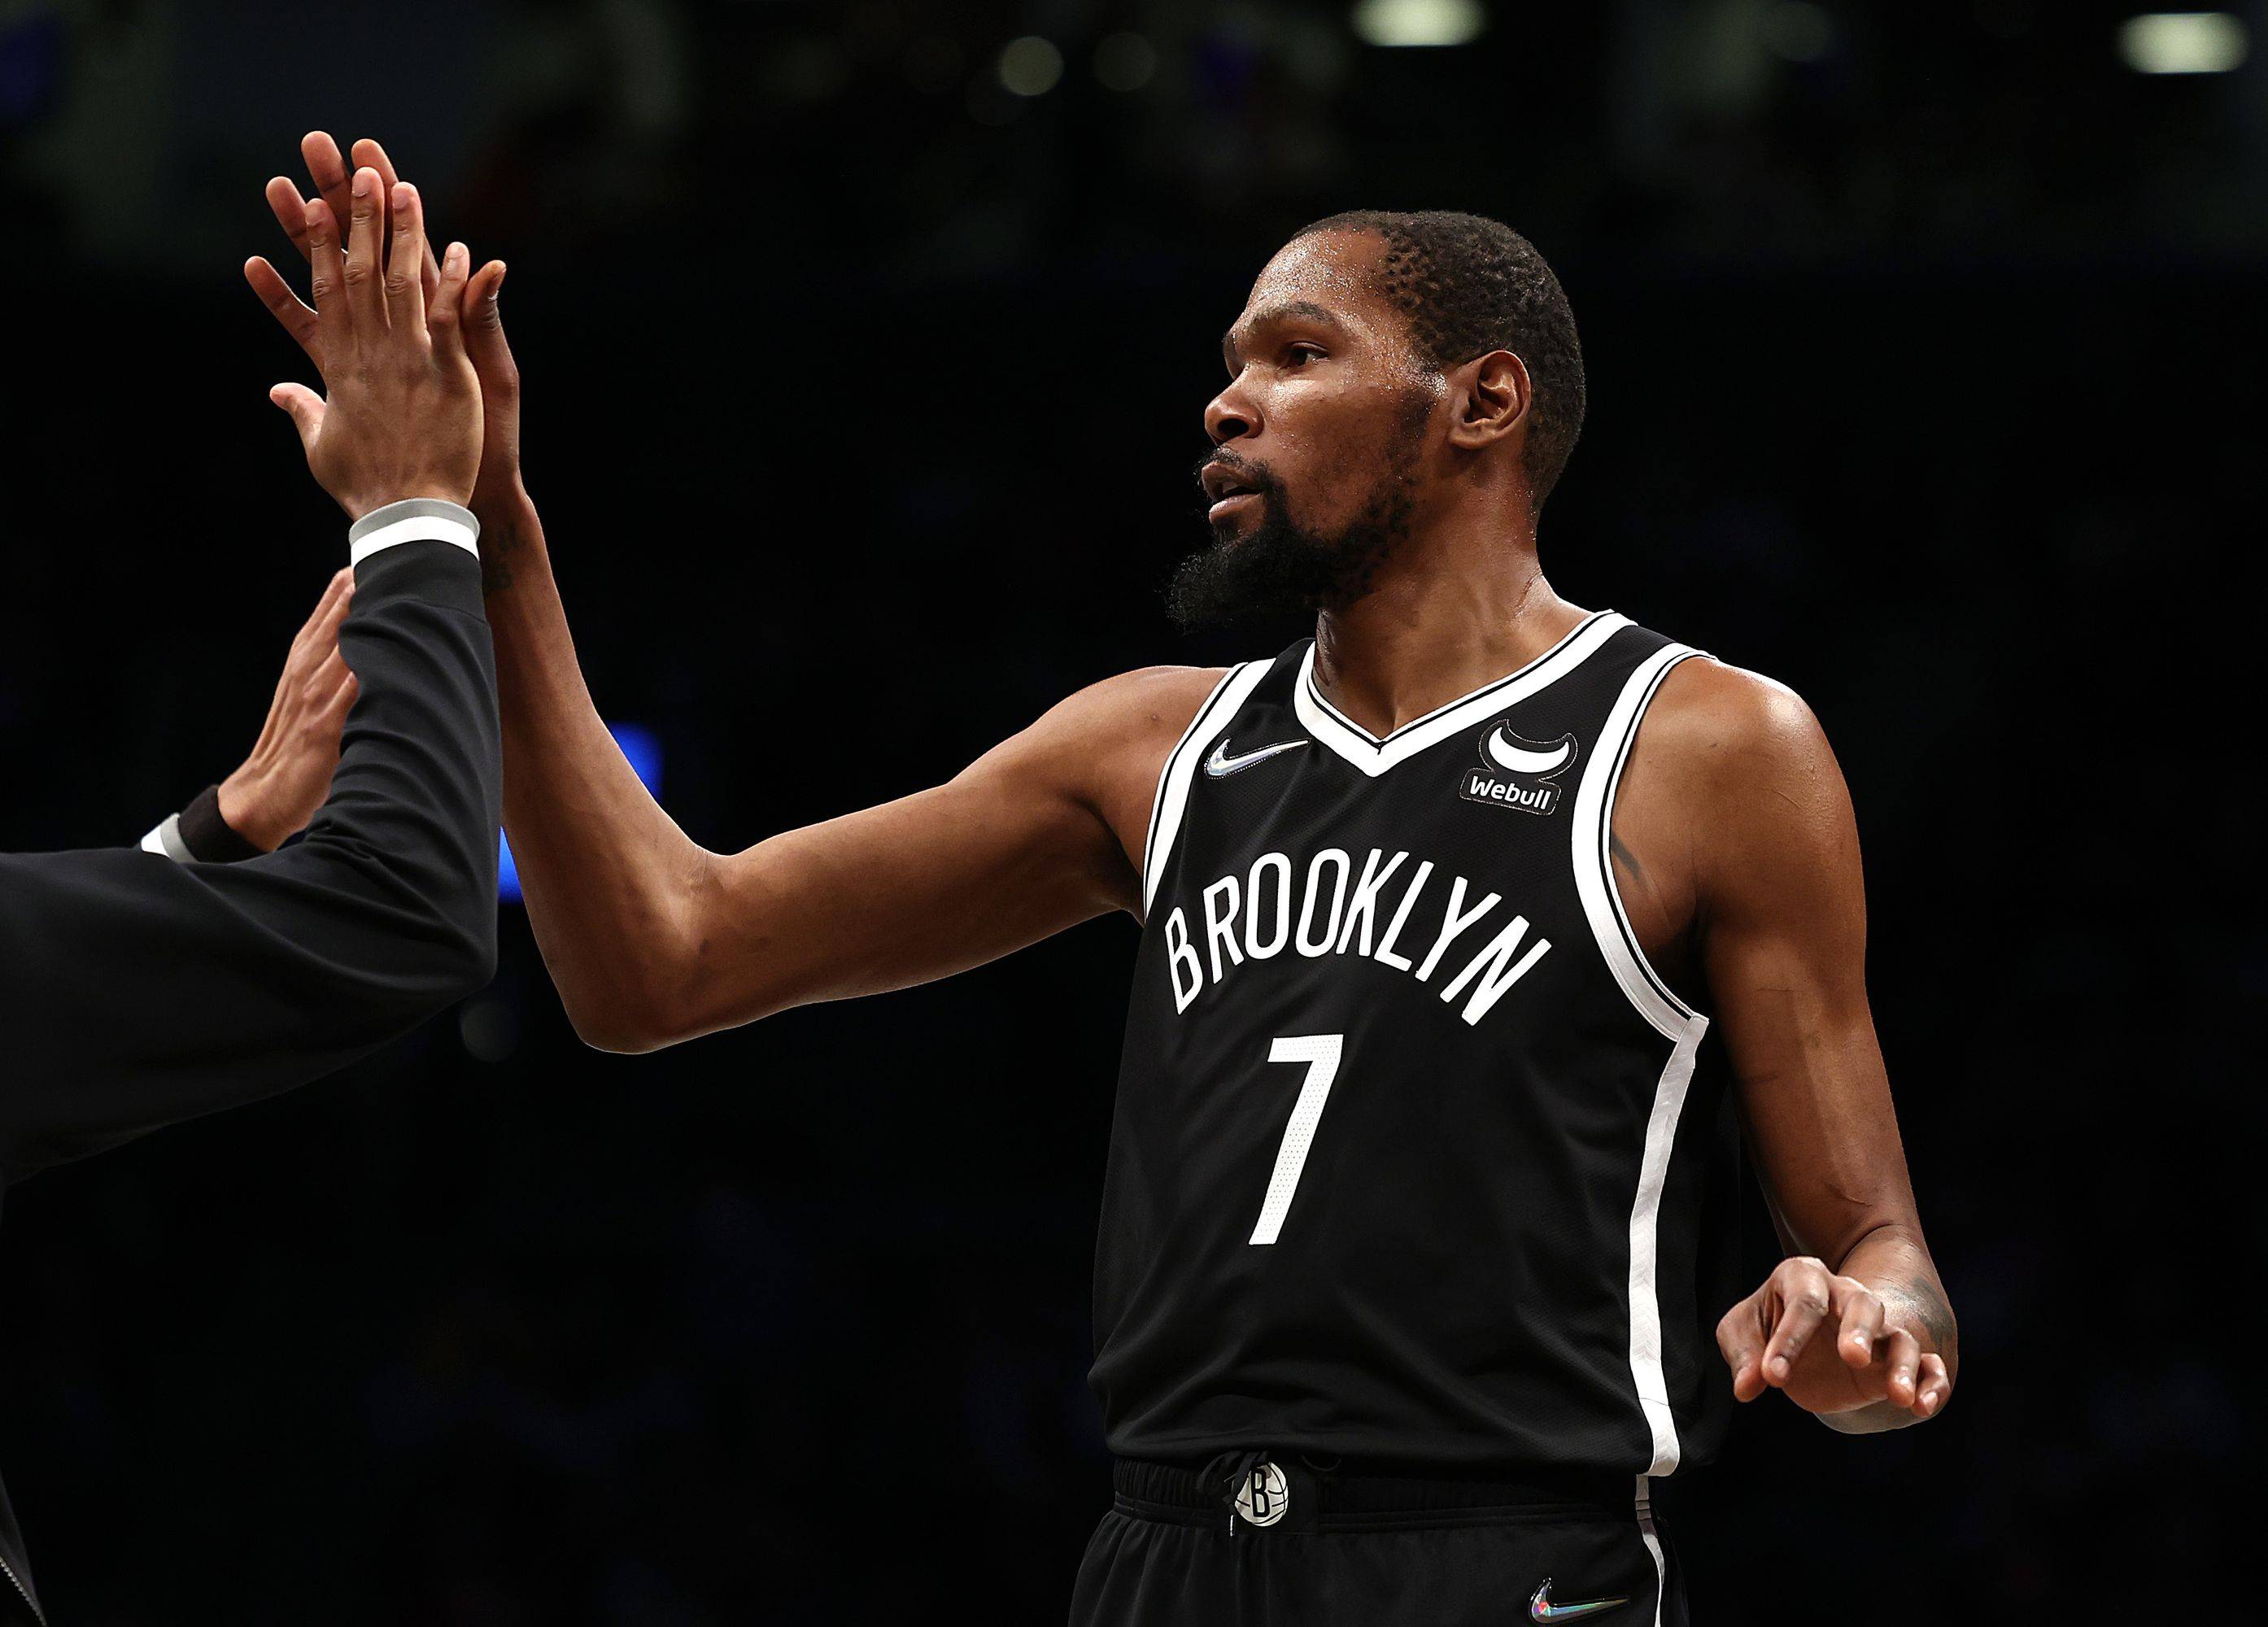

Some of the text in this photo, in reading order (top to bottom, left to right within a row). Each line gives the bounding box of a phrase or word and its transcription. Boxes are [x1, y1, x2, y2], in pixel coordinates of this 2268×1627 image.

[1470, 775, 1551, 810] Webull
[1165, 848, 1552, 1027] BROOKLYN
[1249, 1034, 1344, 1245] 7
[1250, 1468, 1271, 1517] B
